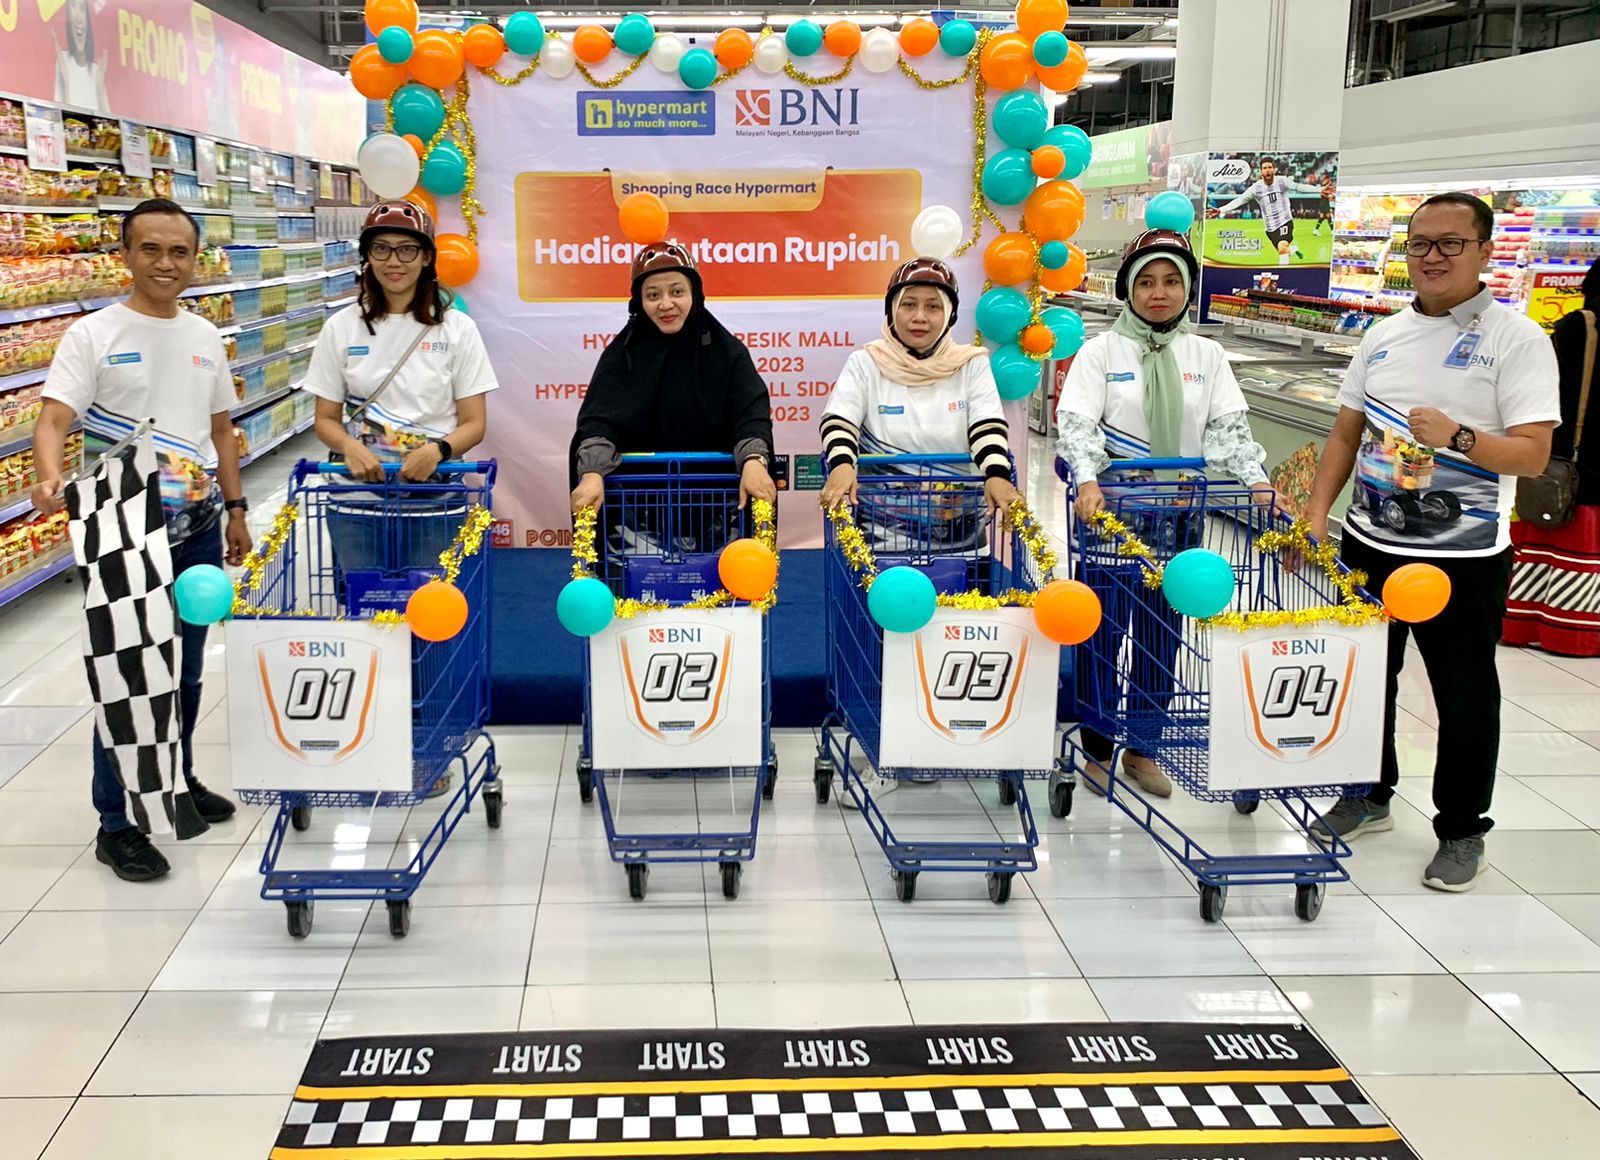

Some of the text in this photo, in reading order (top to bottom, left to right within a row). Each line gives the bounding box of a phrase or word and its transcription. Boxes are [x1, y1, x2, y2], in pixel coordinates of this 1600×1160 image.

[118, 9, 188, 86] PROMO
[616, 99, 708, 118] hypermart
[779, 88, 860, 126] BNI
[617, 119, 707, 128] so much more...
[793, 129, 834, 137] Kebanggaan
[1212, 163, 1244, 177] Aice
[621, 181, 817, 198] Shopping Race Hypermart
[1217, 230, 1245, 238] LIONEL
[1279, 225, 1289, 236] 10
[1222, 239, 1262, 250] MESSI
[784, 234, 900, 271] Rupiah
[1541, 275, 1586, 286] PROM
[799, 331, 854, 347] MALL
[432, 342, 448, 352] BNI
[757, 357, 805, 372] 2023
[1471, 354, 1494, 367] BNI
[668, 628, 702, 643] BNI
[964, 626, 999, 640] BNI
[309, 642, 345, 657] BNI
[1291, 639, 1326, 655] BNI
[642, 652, 718, 702] 02
[934, 651, 1013, 701] 03
[285, 668, 356, 720] 01
[1262, 665, 1338, 718] 04
[340, 1033, 1299, 1076] START START START START START START START
